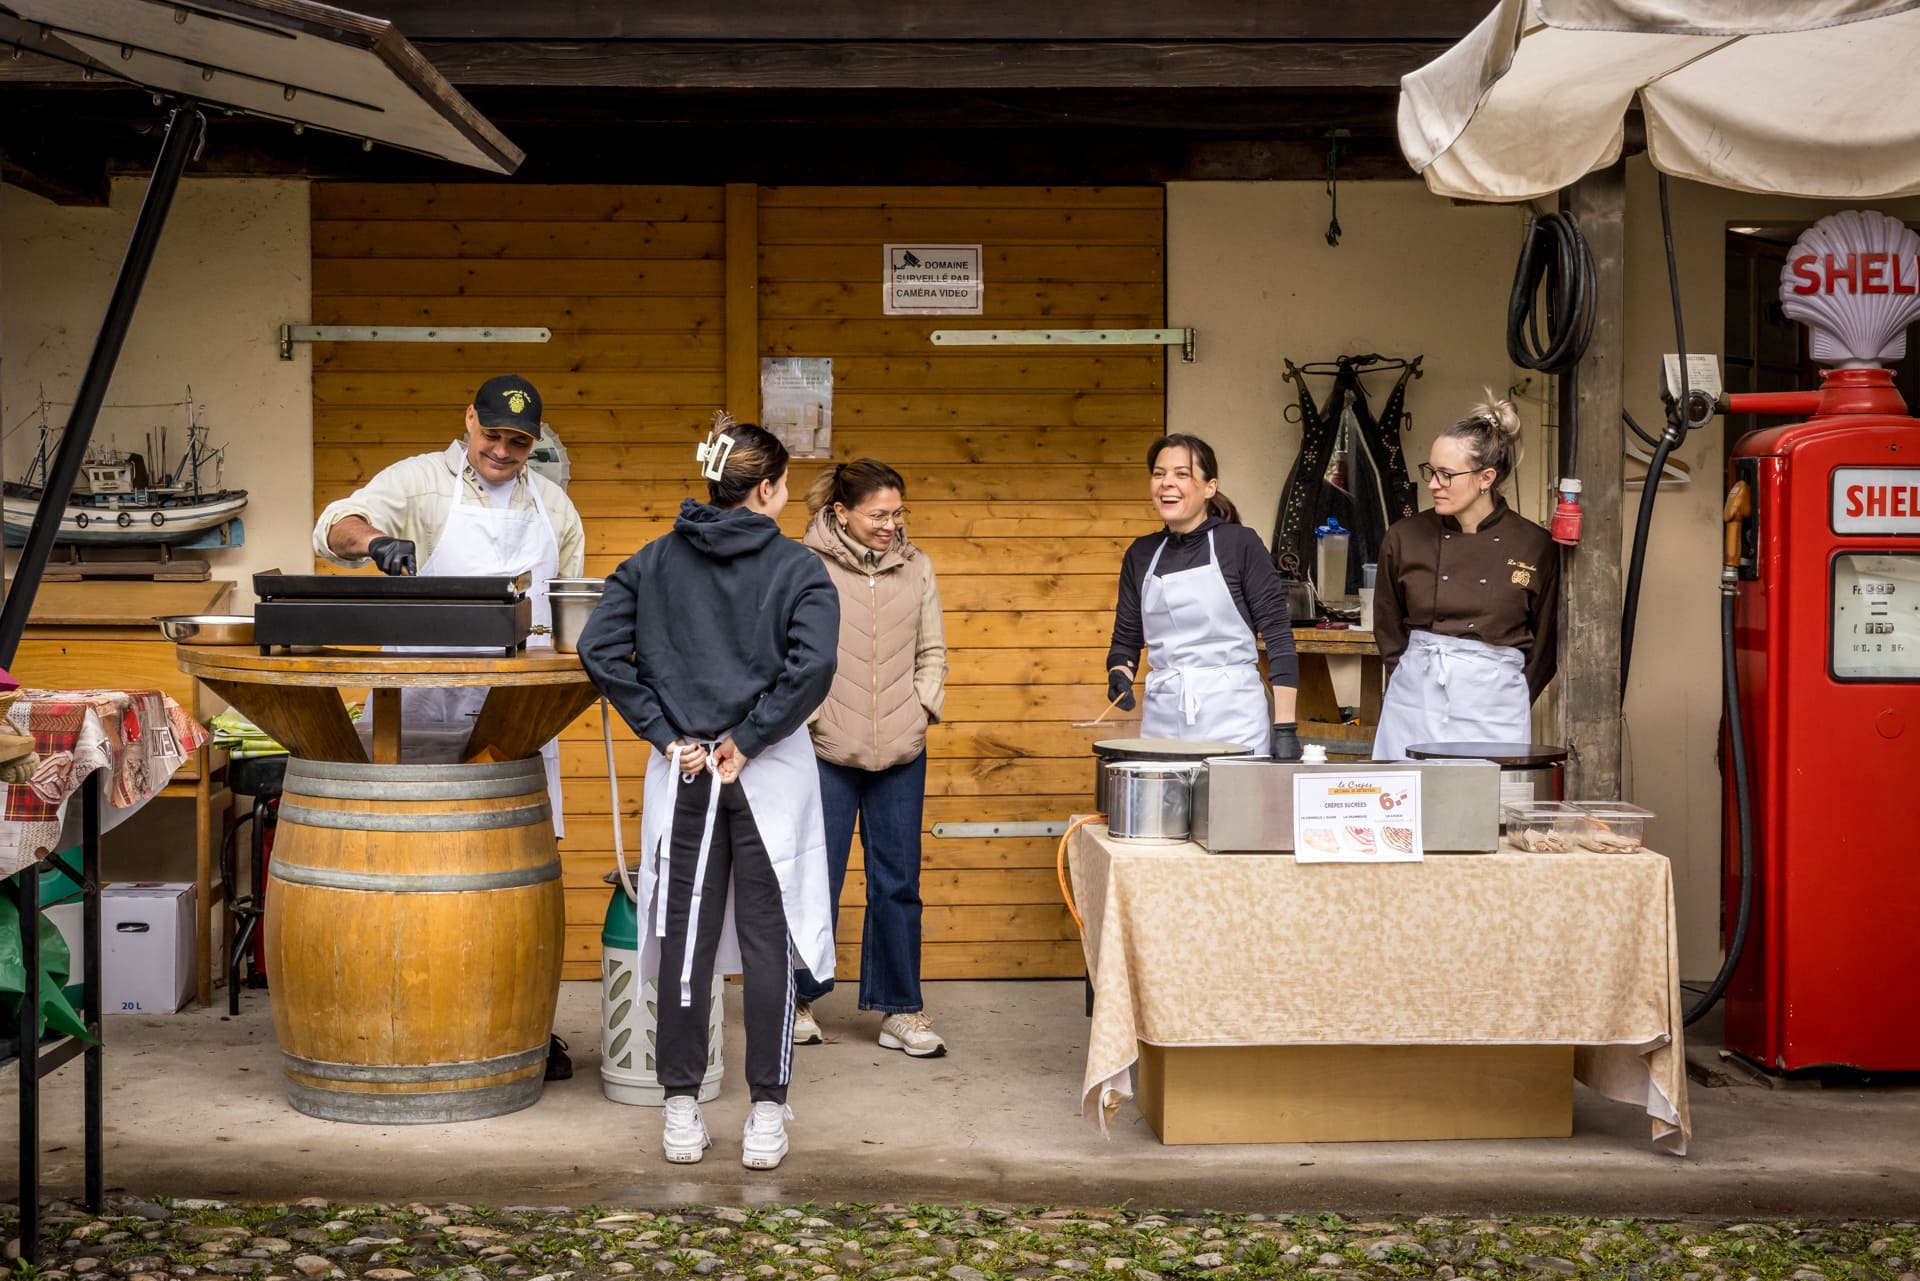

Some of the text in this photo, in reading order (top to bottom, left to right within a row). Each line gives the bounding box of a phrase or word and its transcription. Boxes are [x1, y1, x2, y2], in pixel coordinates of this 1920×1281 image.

[925, 261, 968, 269] DOMAINE
[896, 273, 970, 282] SURVEILLÉ PAR
[1792, 253, 1920, 296] SHEL
[896, 288, 968, 297] CAMÉRA VIDÉO
[1846, 485, 1920, 518] SHEL
[1324, 800, 1367, 809] CRÊPES SUCRÉES
[122, 1002, 142, 1010] 20 L
